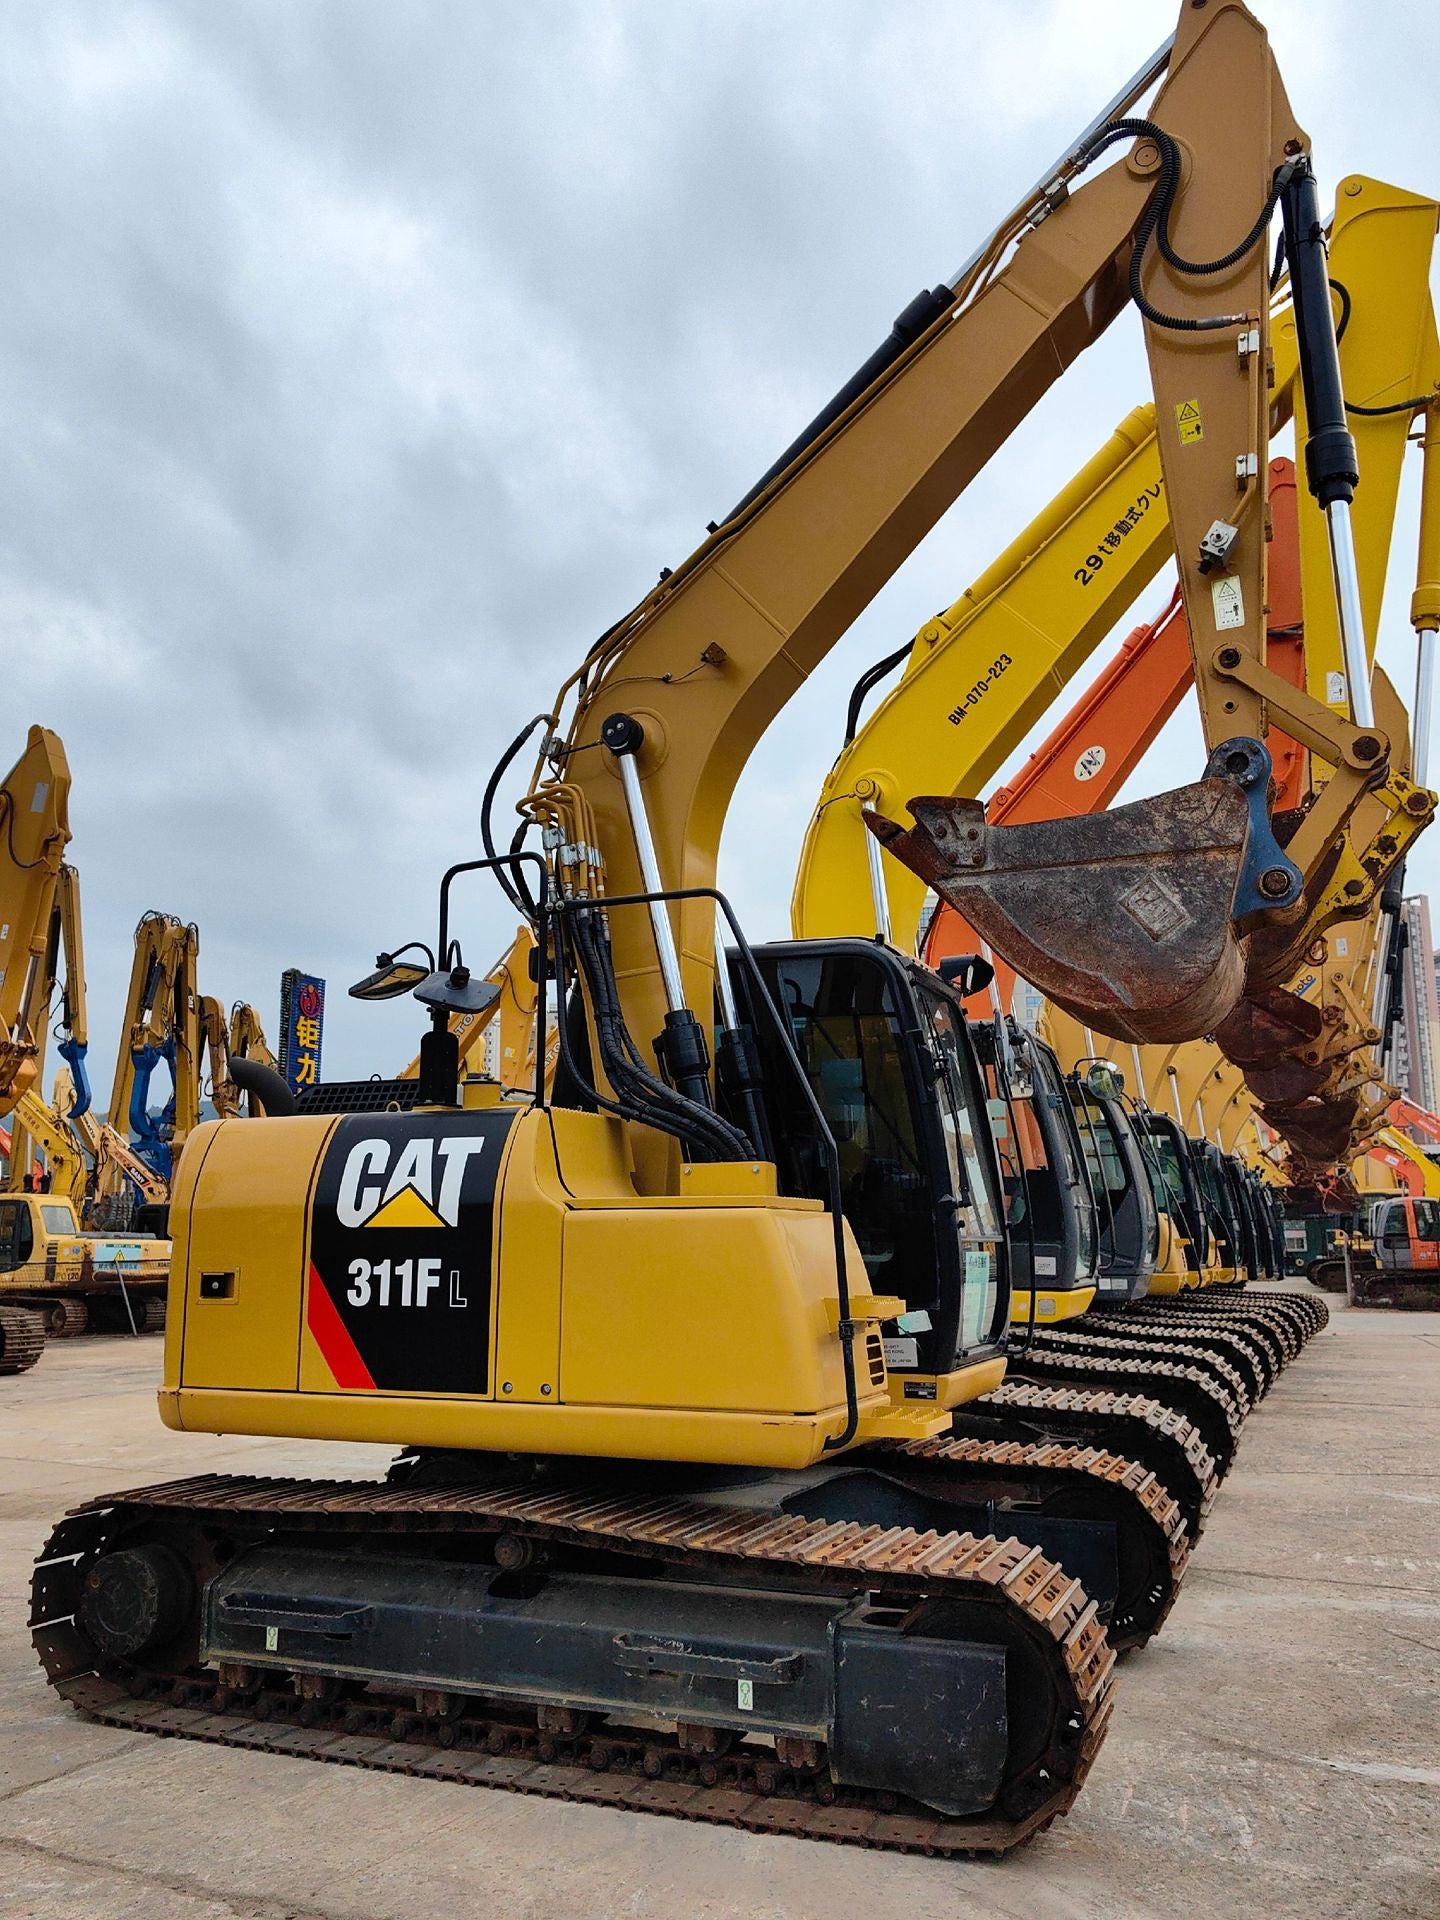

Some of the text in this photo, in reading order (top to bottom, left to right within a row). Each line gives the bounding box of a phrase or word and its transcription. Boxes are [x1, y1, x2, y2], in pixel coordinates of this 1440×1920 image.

[948, 653, 1013, 726] BM-070-223
[295, 1015, 320, 1095] 钜力
[130, 1167, 146, 1184] SANY
[336, 1136, 485, 1229] CAT
[346, 1258, 467, 1307] 311F L
